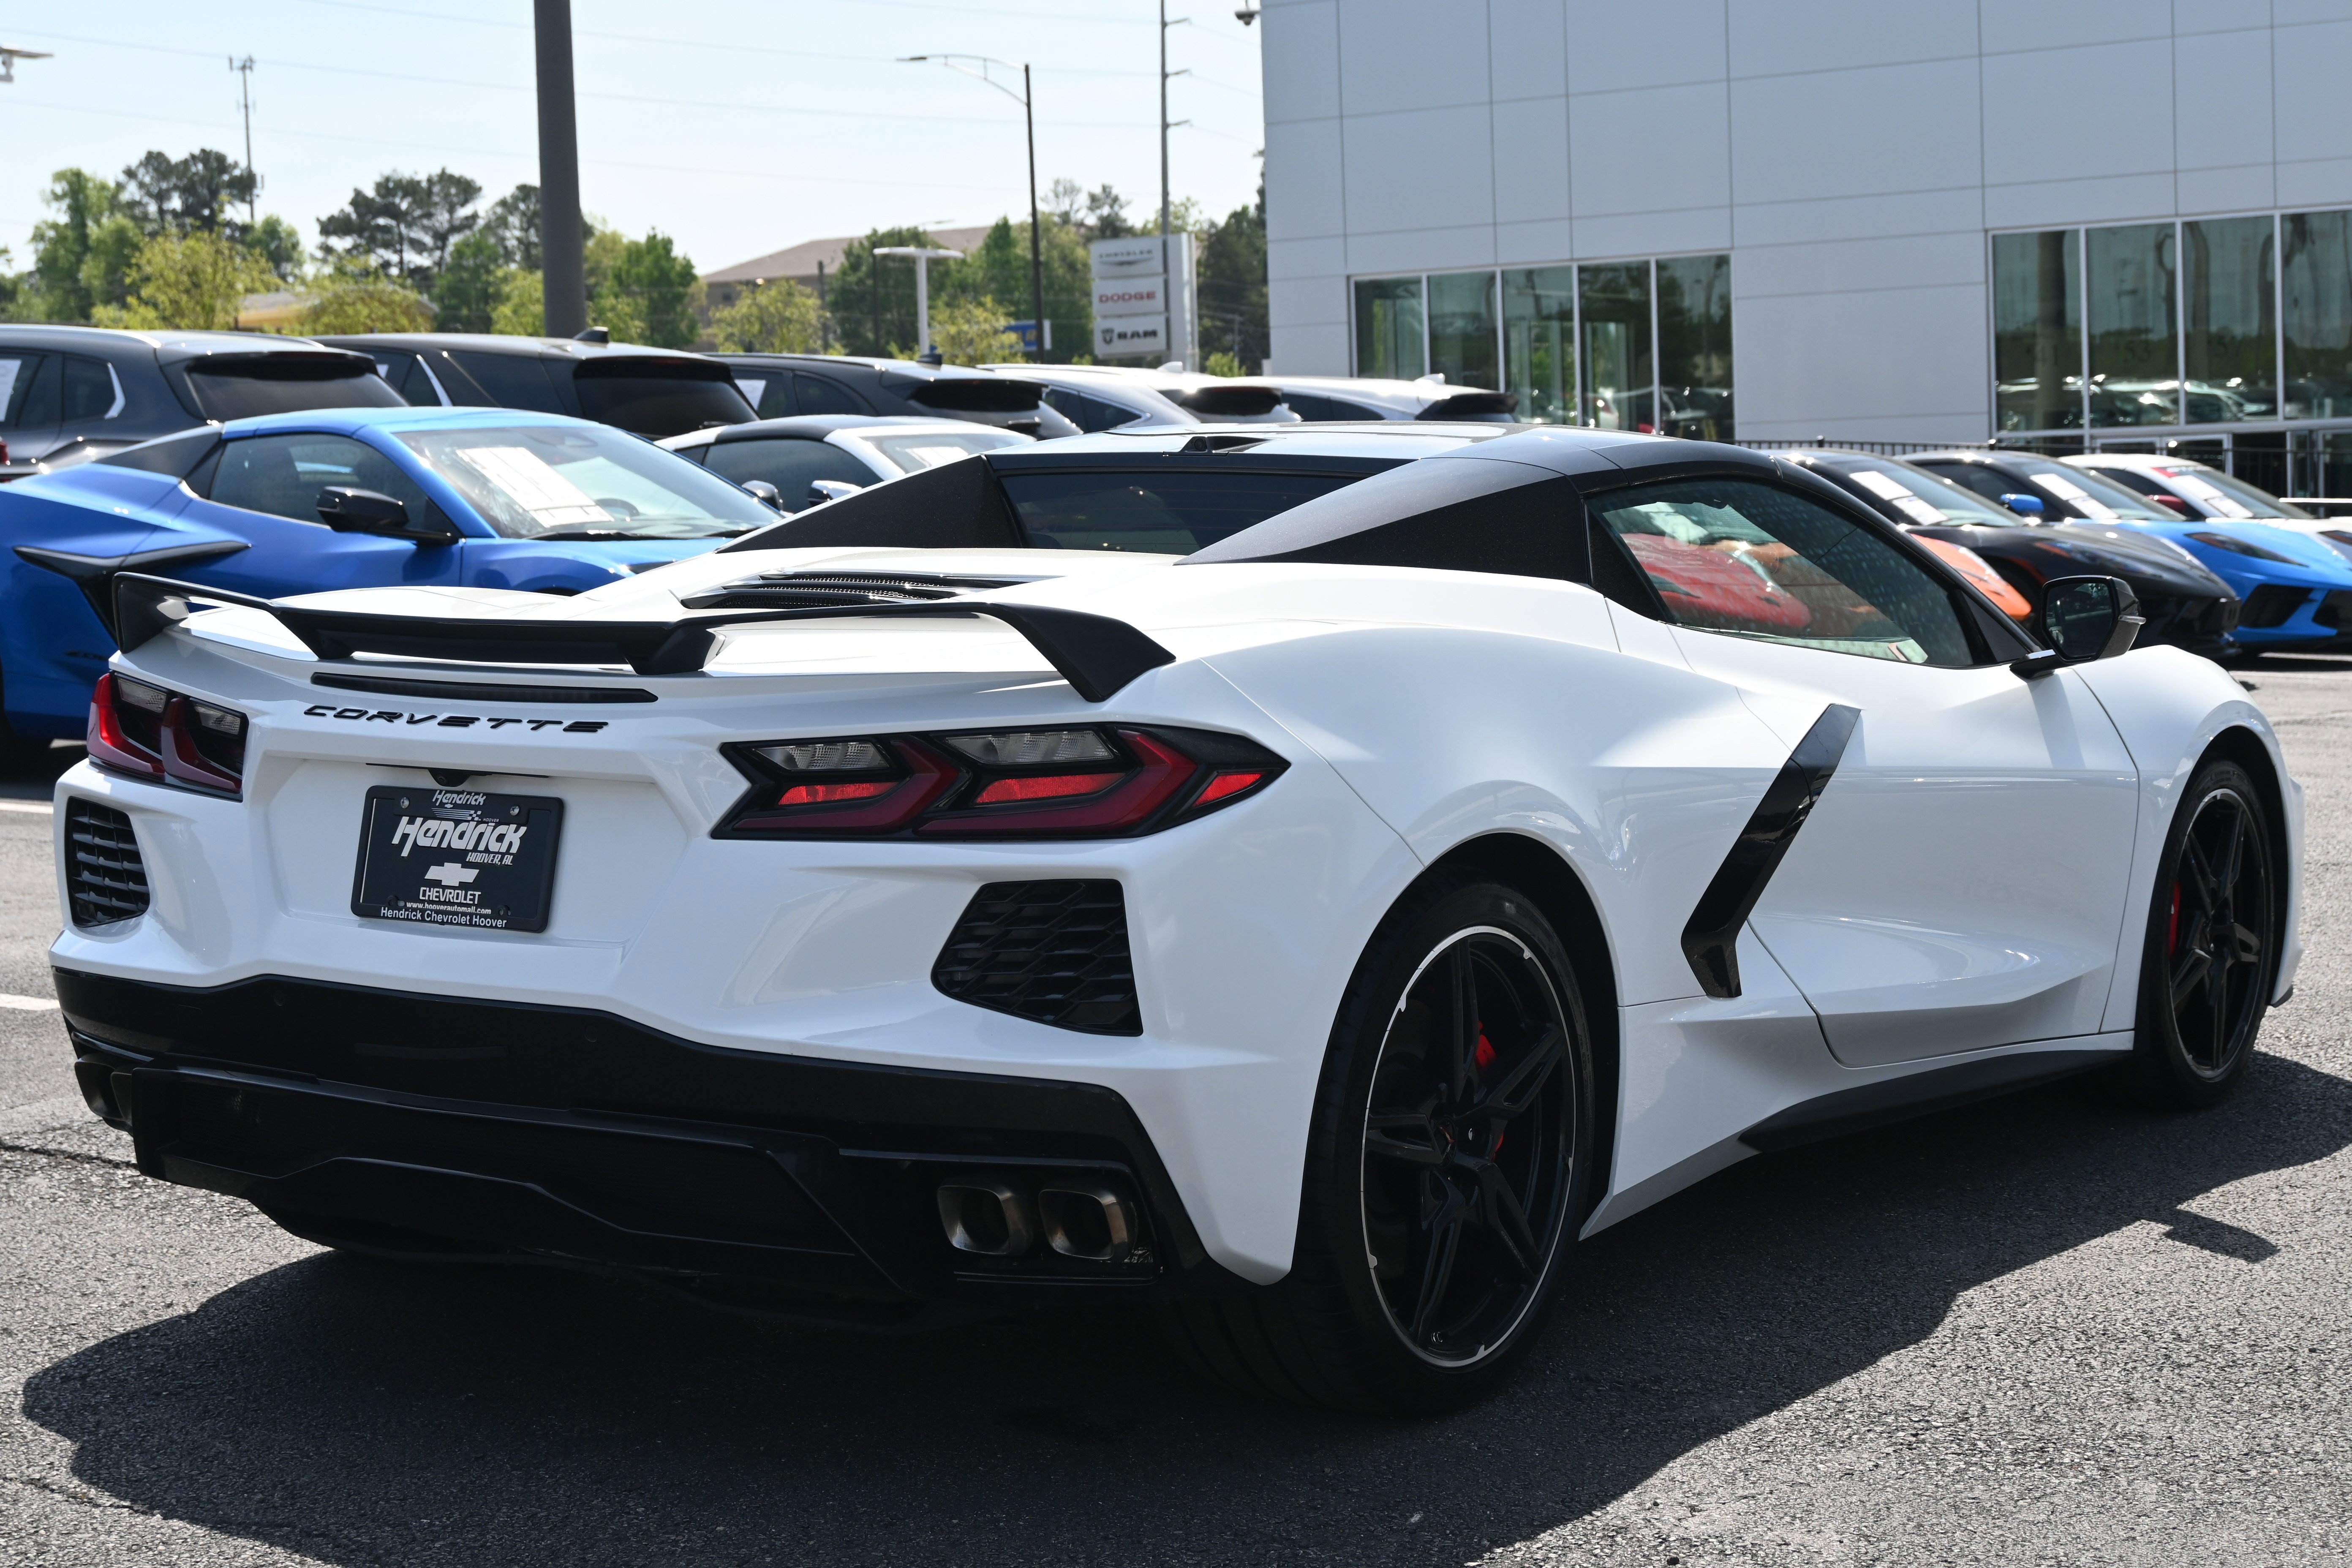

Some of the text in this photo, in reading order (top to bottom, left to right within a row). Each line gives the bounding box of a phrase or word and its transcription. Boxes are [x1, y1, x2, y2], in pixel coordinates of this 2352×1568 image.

[1099, 290, 1156, 303] DODGE
[1117, 329, 1158, 340] RAM
[304, 705, 609, 732] CORVETTE
[432, 790, 486, 806] Hendrick
[392, 816, 527, 857] Hendrick
[466, 852, 513, 865] HOOVER, AL
[419, 887, 482, 904] CHEVROLET
[406, 902, 491, 915] www.hooverautomall.com
[381, 907, 507, 928] Hendrick Chevrolet Hoover
